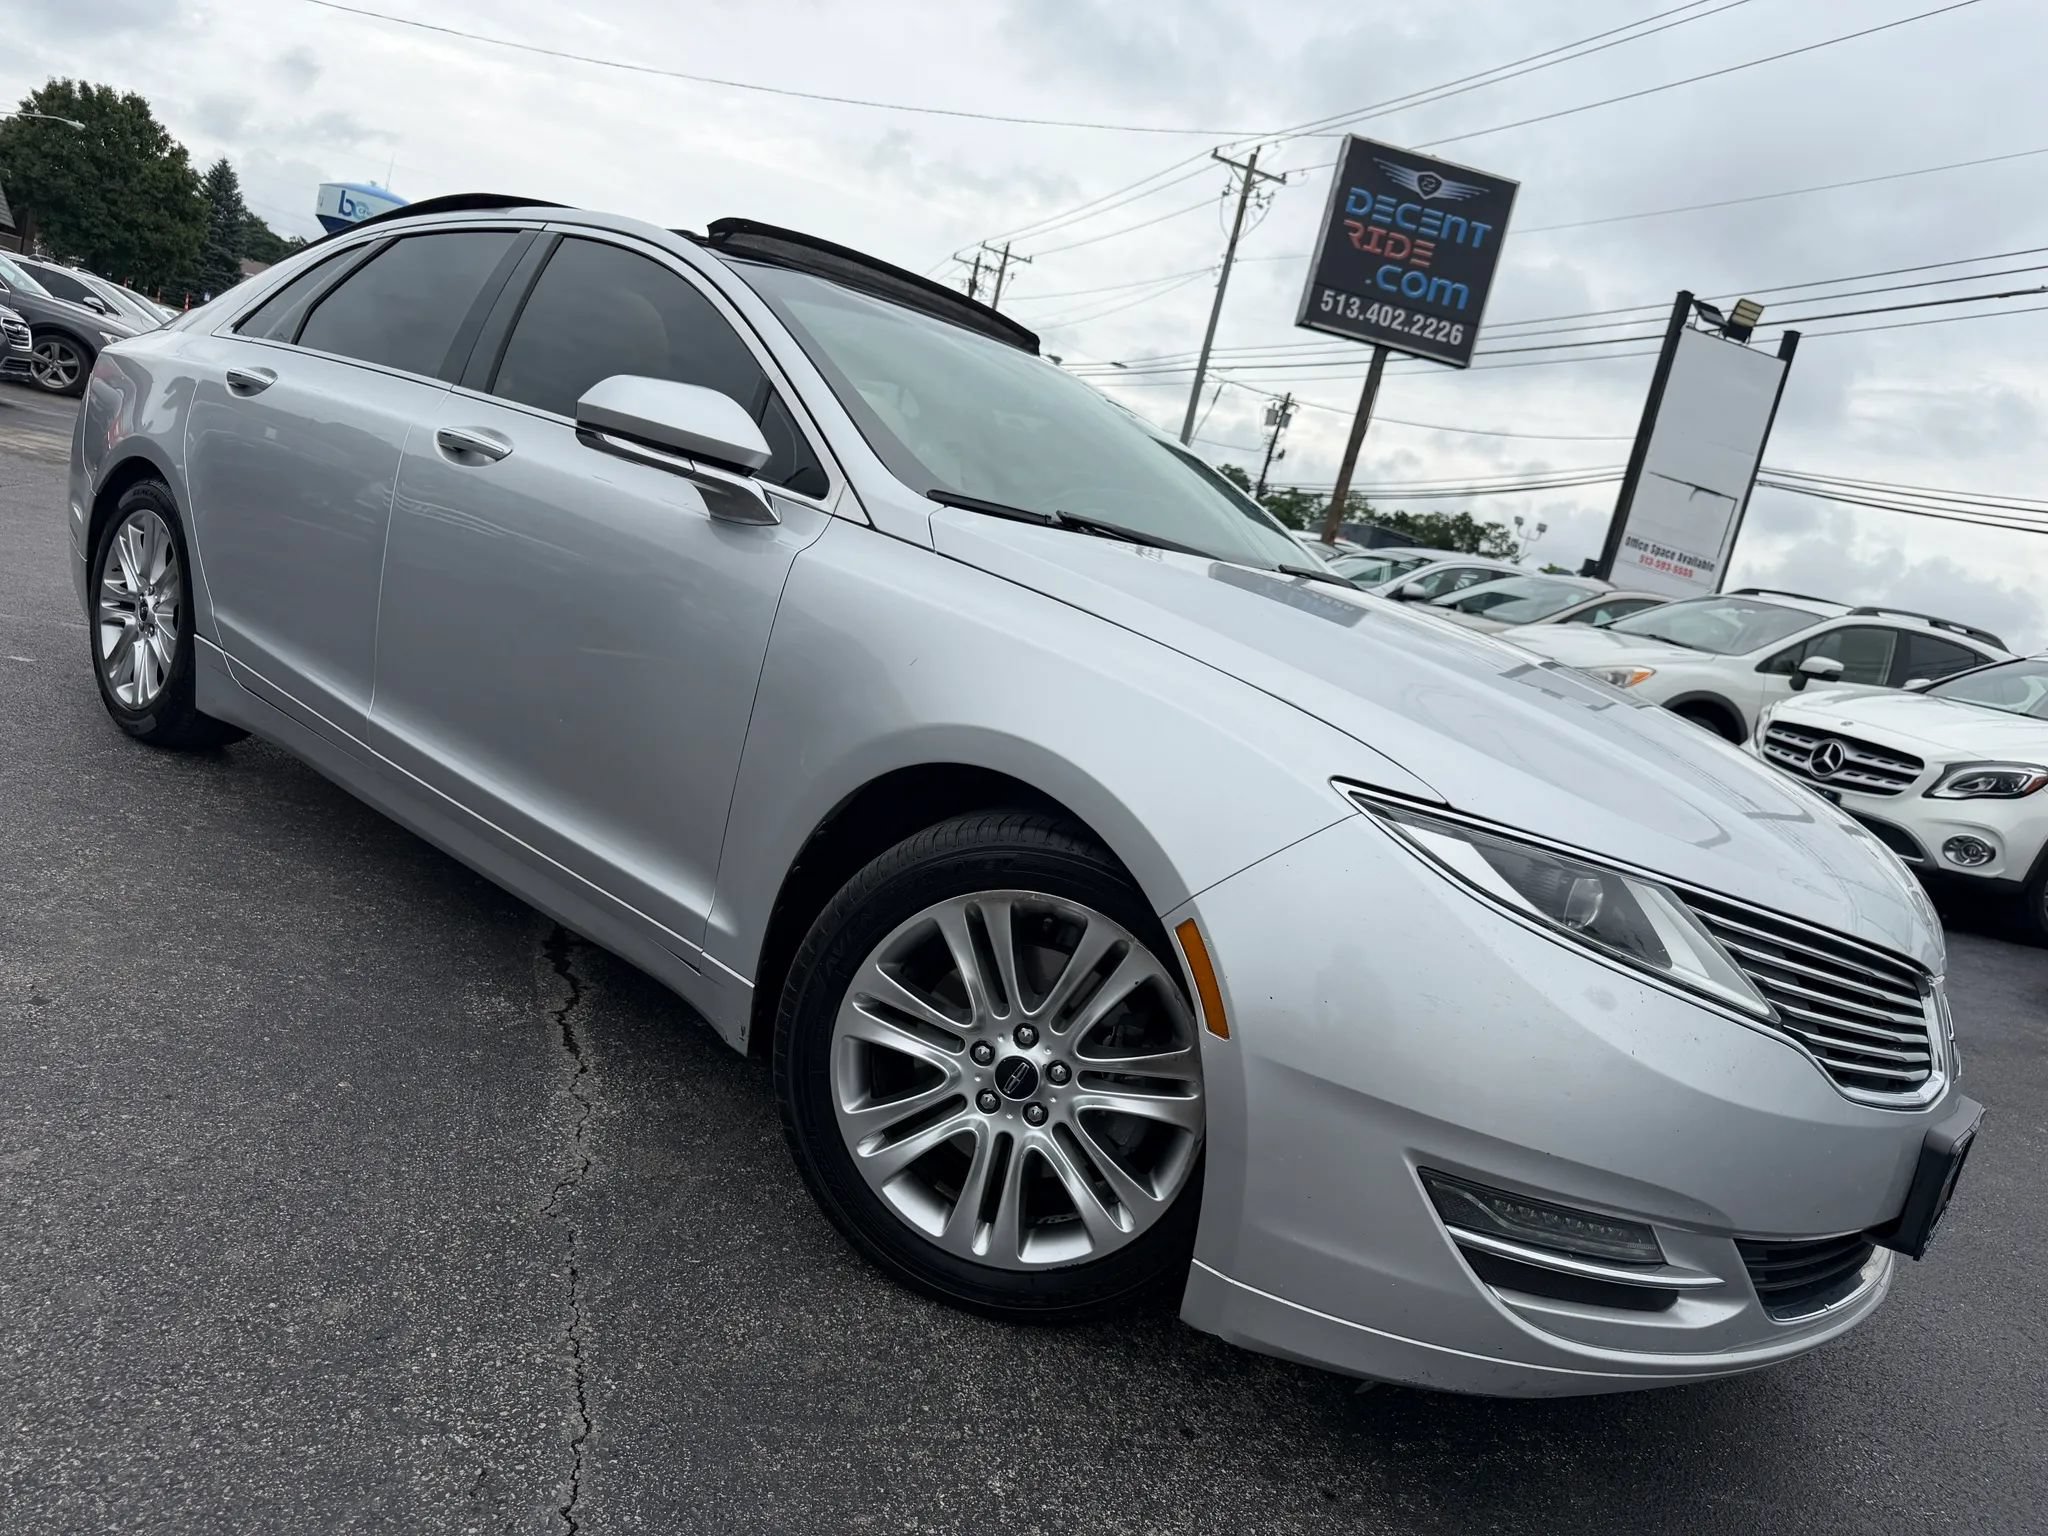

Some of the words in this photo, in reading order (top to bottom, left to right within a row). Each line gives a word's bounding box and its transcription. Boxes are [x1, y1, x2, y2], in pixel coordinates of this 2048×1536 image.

[1344, 219, 1436, 268] RIDE
[1345, 187, 1492, 248] DECENT
[1320, 290, 1465, 346] 513.402.2226
[1625, 535, 1649, 552] Office
[1650, 544, 1676, 560] Space
[1677, 552, 1715, 573] Available
